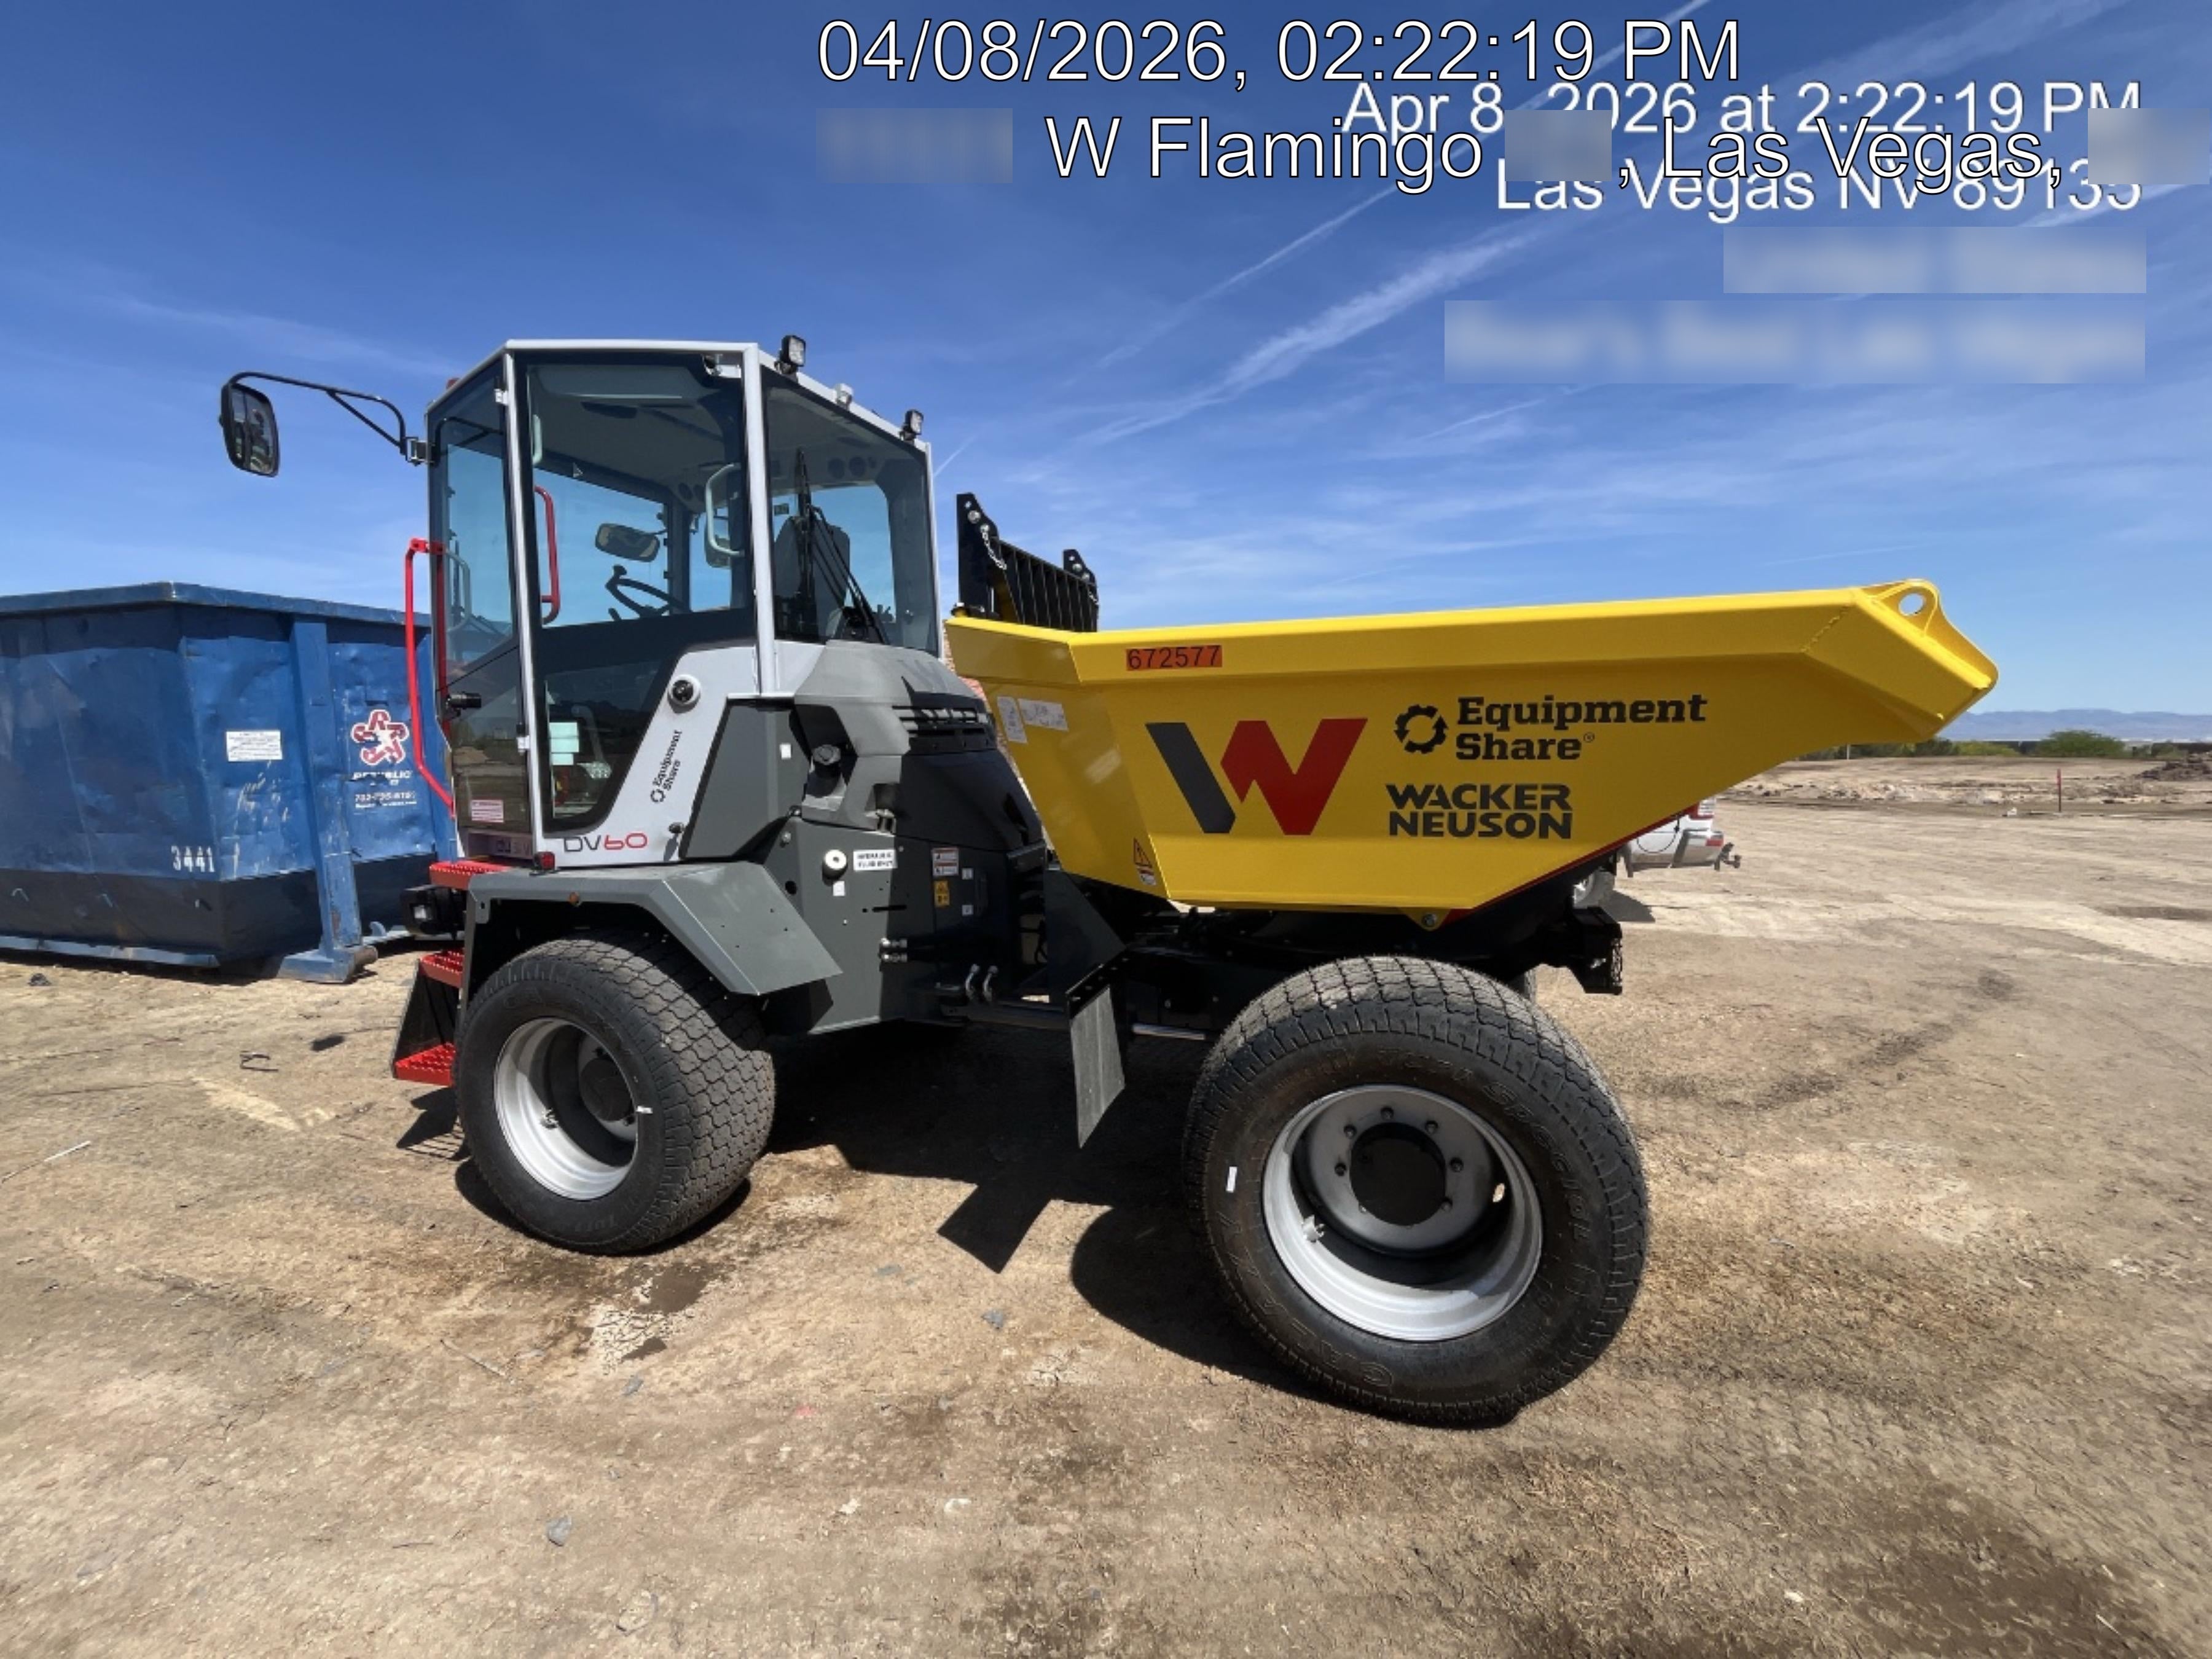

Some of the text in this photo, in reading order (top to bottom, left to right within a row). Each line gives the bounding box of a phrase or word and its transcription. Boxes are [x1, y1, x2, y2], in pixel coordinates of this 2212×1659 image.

[1128, 645, 1221, 670] 672577
[1457, 694, 1708, 731] Equipment
[653, 729, 683, 787] Equipment
[663, 759, 681, 791] Share
[1386, 783, 1572, 810] WACKER
[1388, 812, 1572, 839] NEUSON
[563, 832, 648, 852] DV60
[171, 845, 214, 873] 3441
